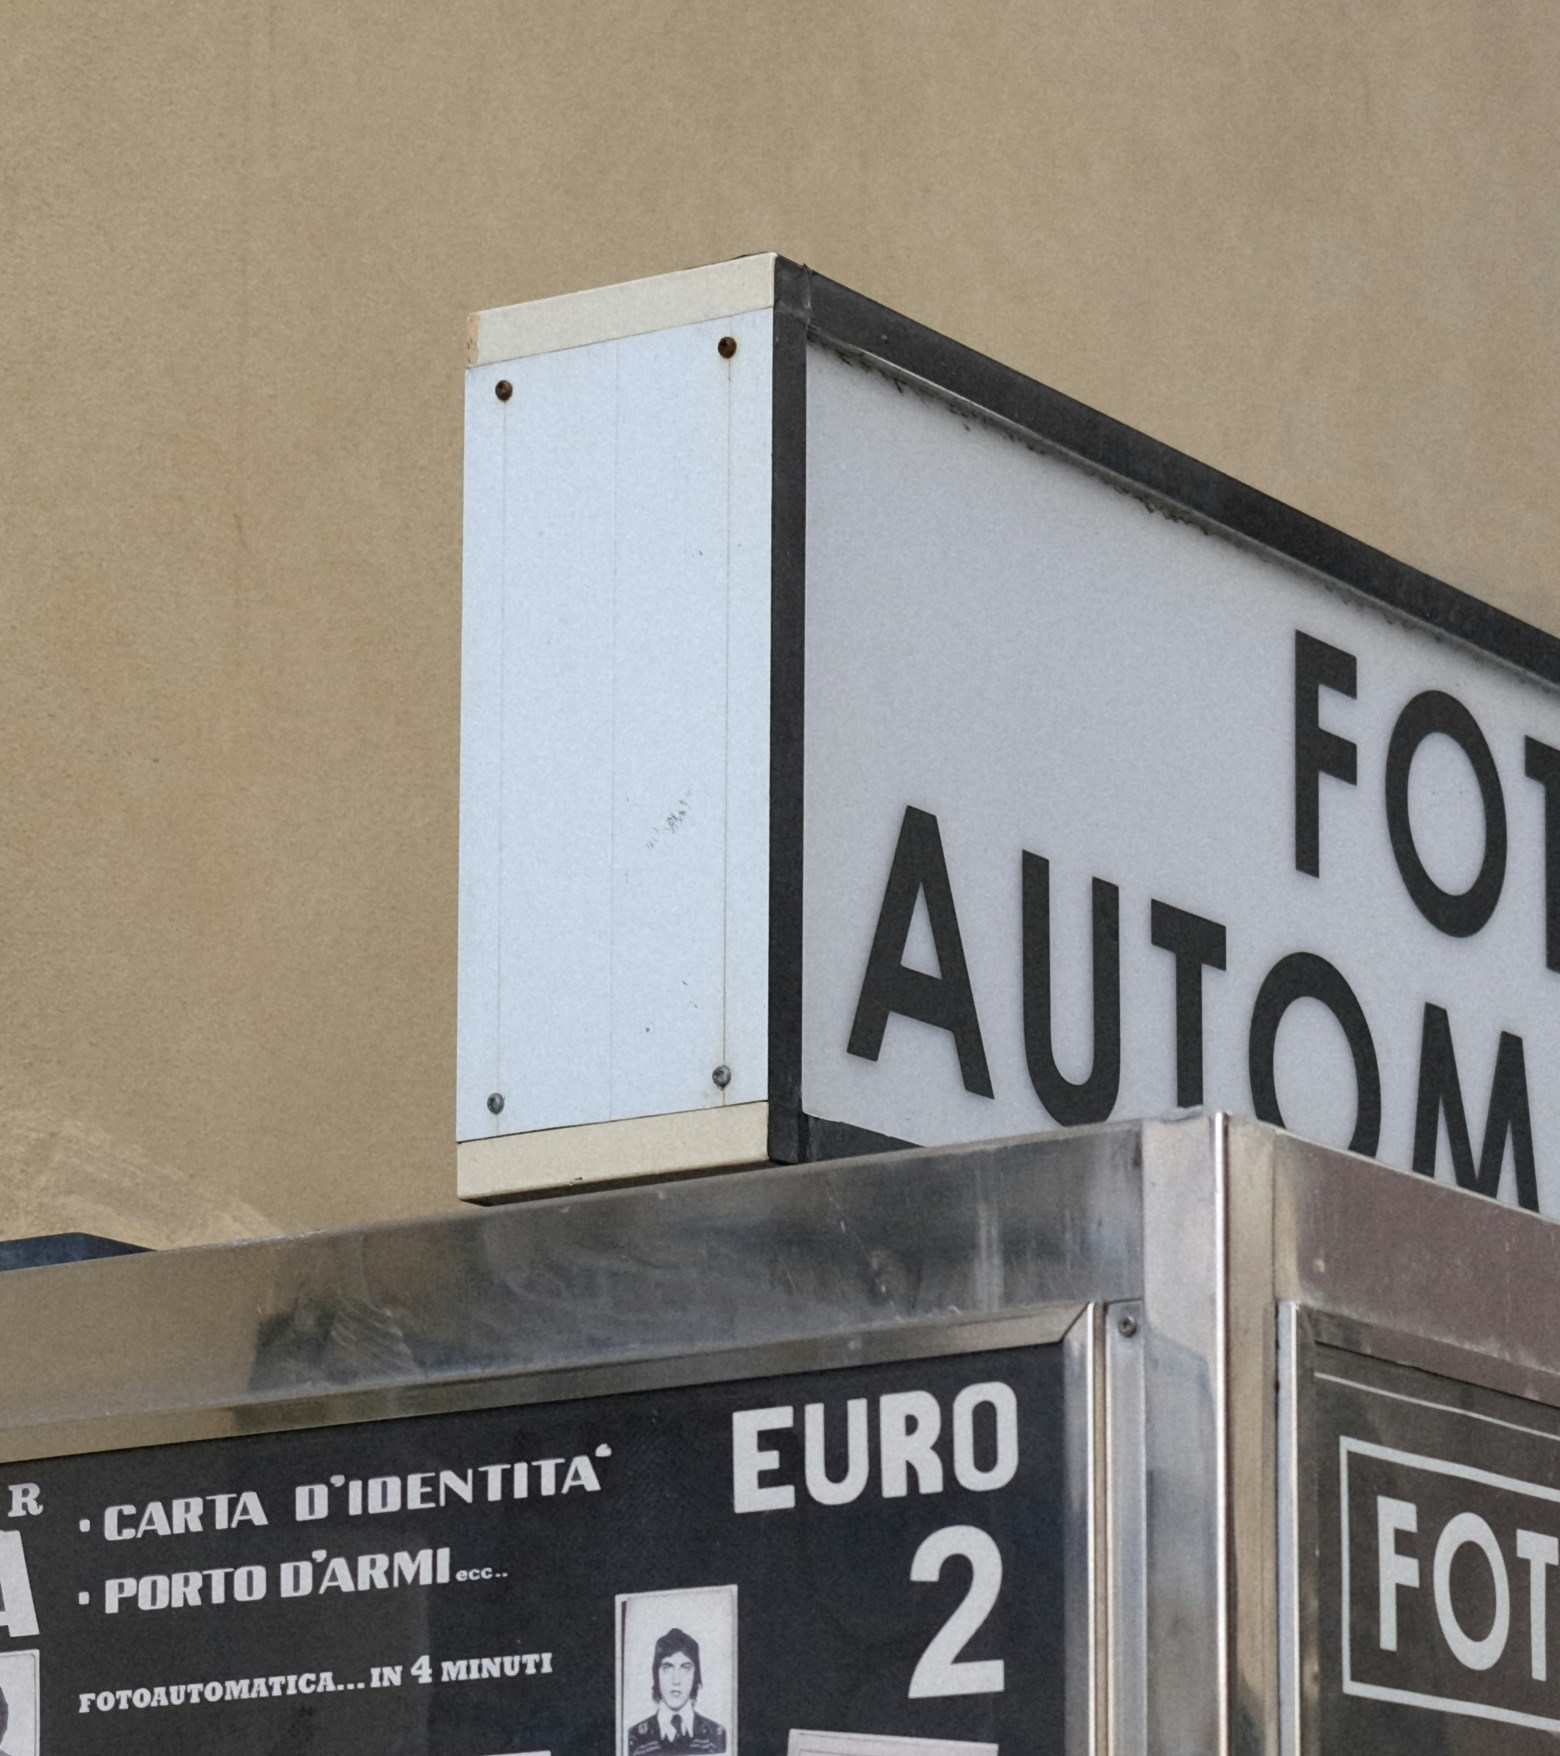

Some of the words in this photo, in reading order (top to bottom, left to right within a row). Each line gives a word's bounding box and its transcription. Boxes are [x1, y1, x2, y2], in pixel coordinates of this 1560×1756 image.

[732, 1380, 1019, 1514] EURO
[103, 1490, 269, 1542] CARTA
[103, 1565, 267, 1614] PORTO
[280, 1546, 451, 1600] D'ARMI
[907, 1524, 1006, 1700] 2
[77, 1670, 366, 1714] FOTOAUTOMATICA...
[370, 1664, 403, 1688] IN
[411, 1653, 433, 1685] 4
[441, 1651, 554, 1683] MINUTI
